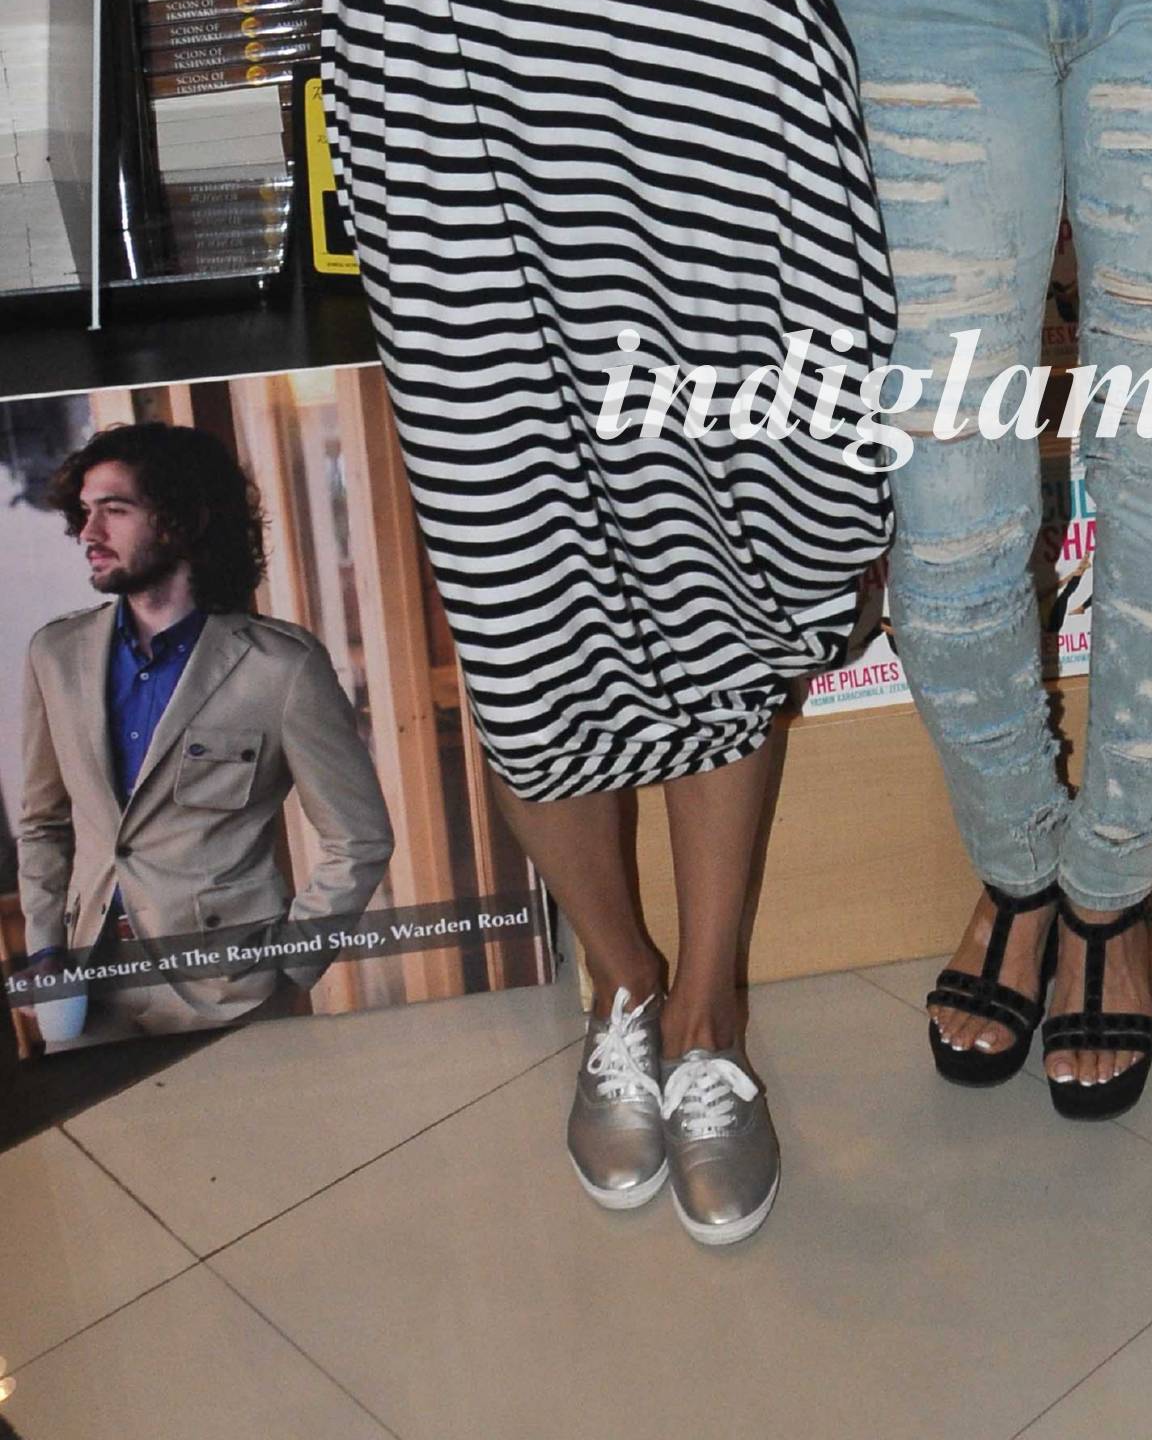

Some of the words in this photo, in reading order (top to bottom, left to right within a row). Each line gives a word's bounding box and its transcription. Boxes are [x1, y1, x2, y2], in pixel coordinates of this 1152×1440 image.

[808, 672, 836, 696] THE
[839, 662, 900, 691] PILATES
[35, 974, 56, 988] to
[63, 959, 153, 984] Measure
[158, 953, 178, 971] at
[182, 949, 220, 968] The
[226, 935, 322, 964] Raymond
[328, 930, 386, 950] Shop,
[391, 917, 472, 941] Warden
[478, 907, 529, 929] Road
